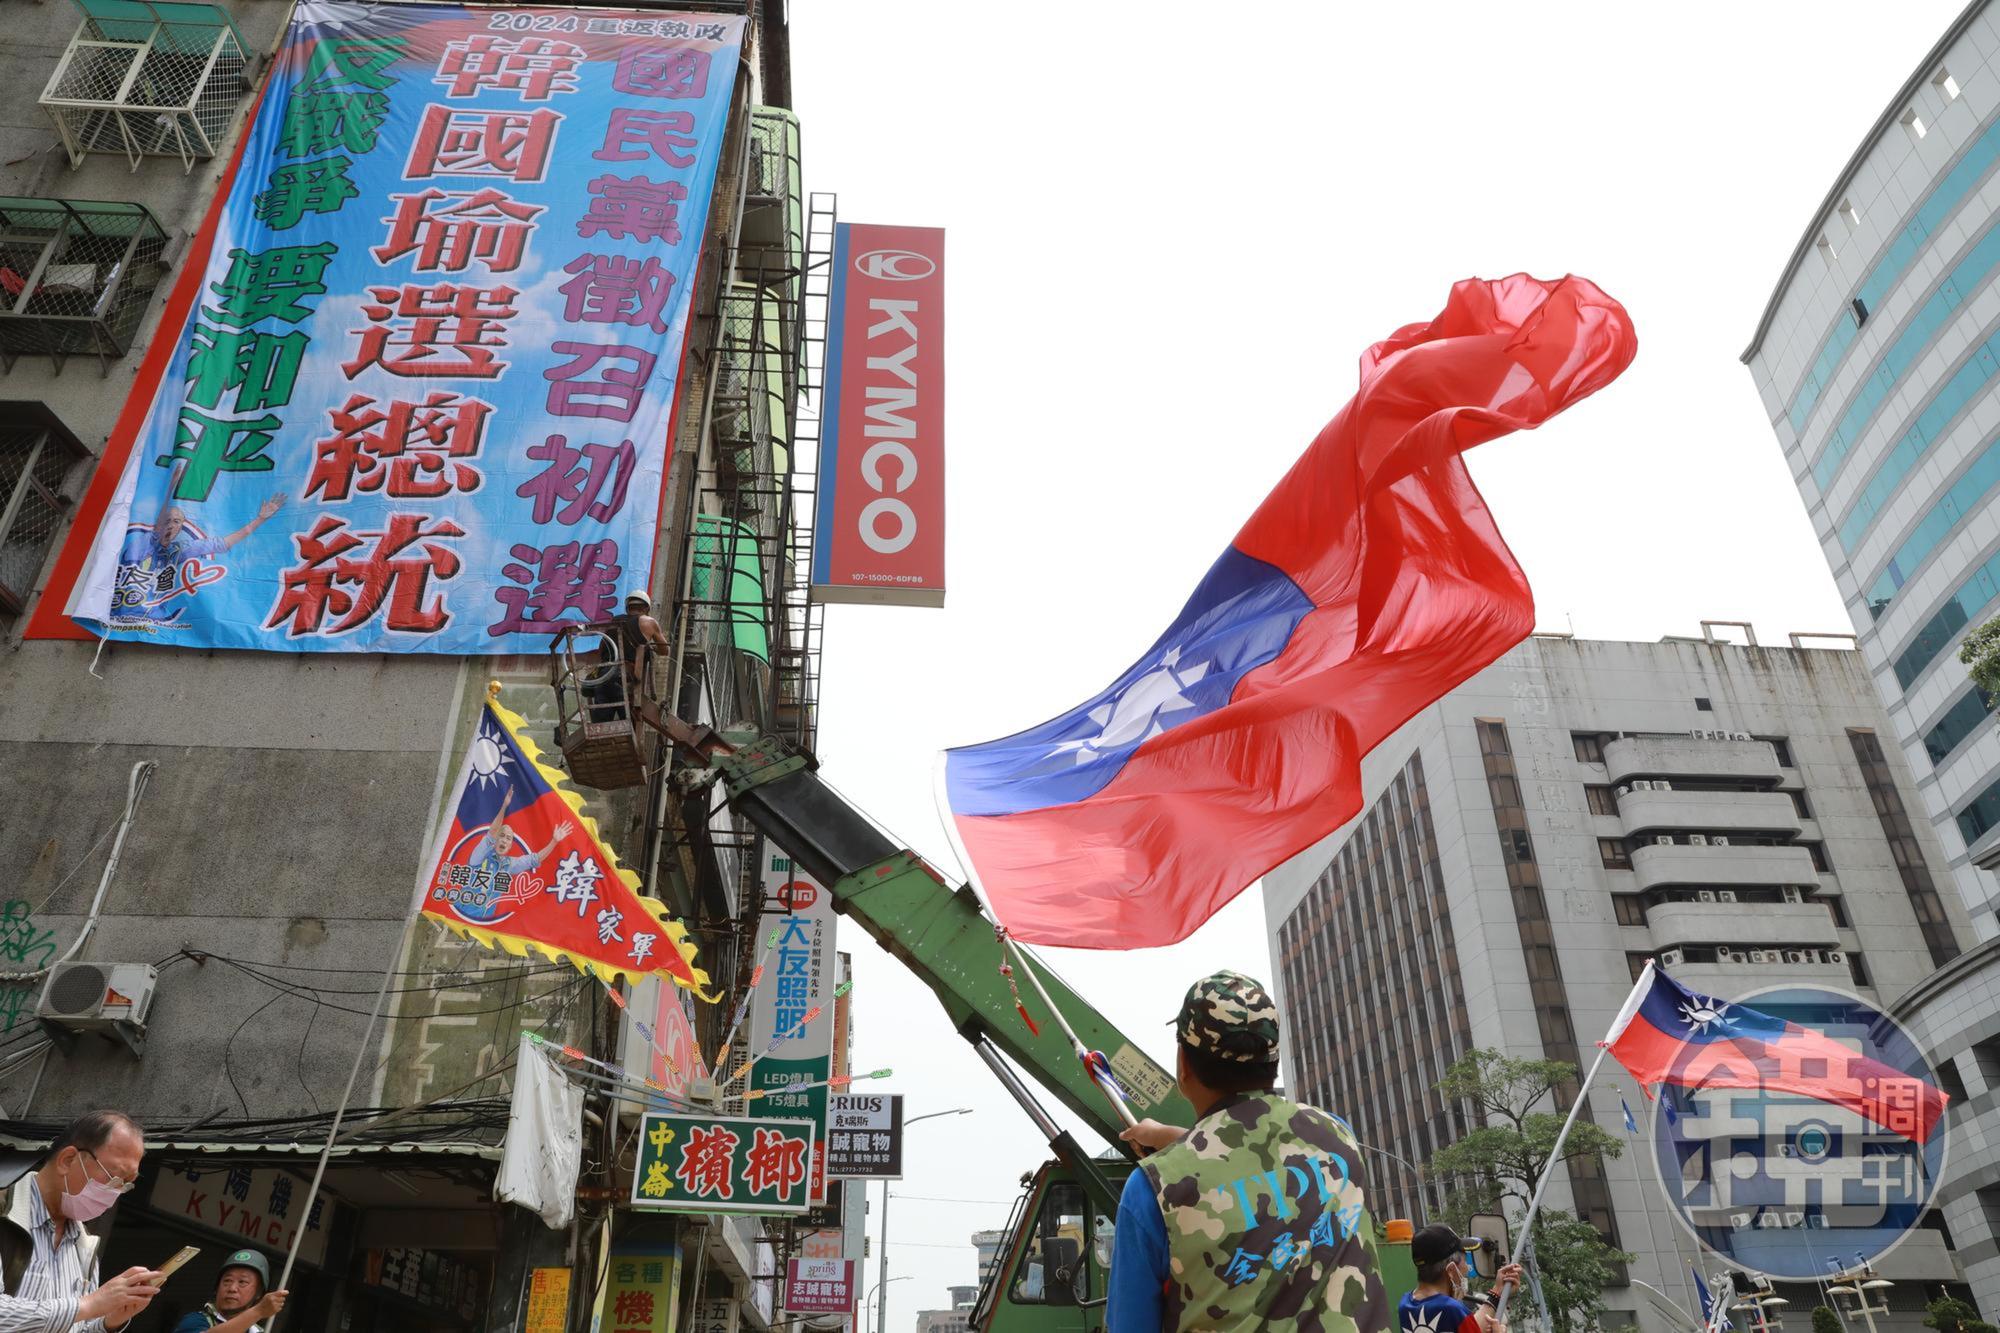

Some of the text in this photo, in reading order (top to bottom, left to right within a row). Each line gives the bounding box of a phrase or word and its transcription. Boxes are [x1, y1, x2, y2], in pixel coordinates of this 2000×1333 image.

[488, 12, 727, 42] 2024 重返執政
[262, 34, 587, 638] 韓國瑜選總統
[486, 46, 711, 637] 國民黨徵召初選
[155, 241, 339, 502] 要和平
[858, 298, 919, 554] KYMCO
[113, 565, 176, 592] 友會
[449, 864, 513, 893] 韓友會
[547, 850, 659, 966] 韓家軍
[772, 915, 811, 1039] 大友照明
[810, 918, 823, 998] 全方位照明領先者
[830, 1096, 882, 1113] RIUS
[835, 1115, 869, 1127] 克瑞斯
[640, 1121, 676, 1198] 中崙
[676, 1124, 807, 1201] 檳榔
[829, 1133, 891, 1152] 誠寵物
[615, 1262, 664, 1284] 各種
[792, 1282, 847, 1296] 志誠寵物
[613, 1290, 655, 1333] 機
